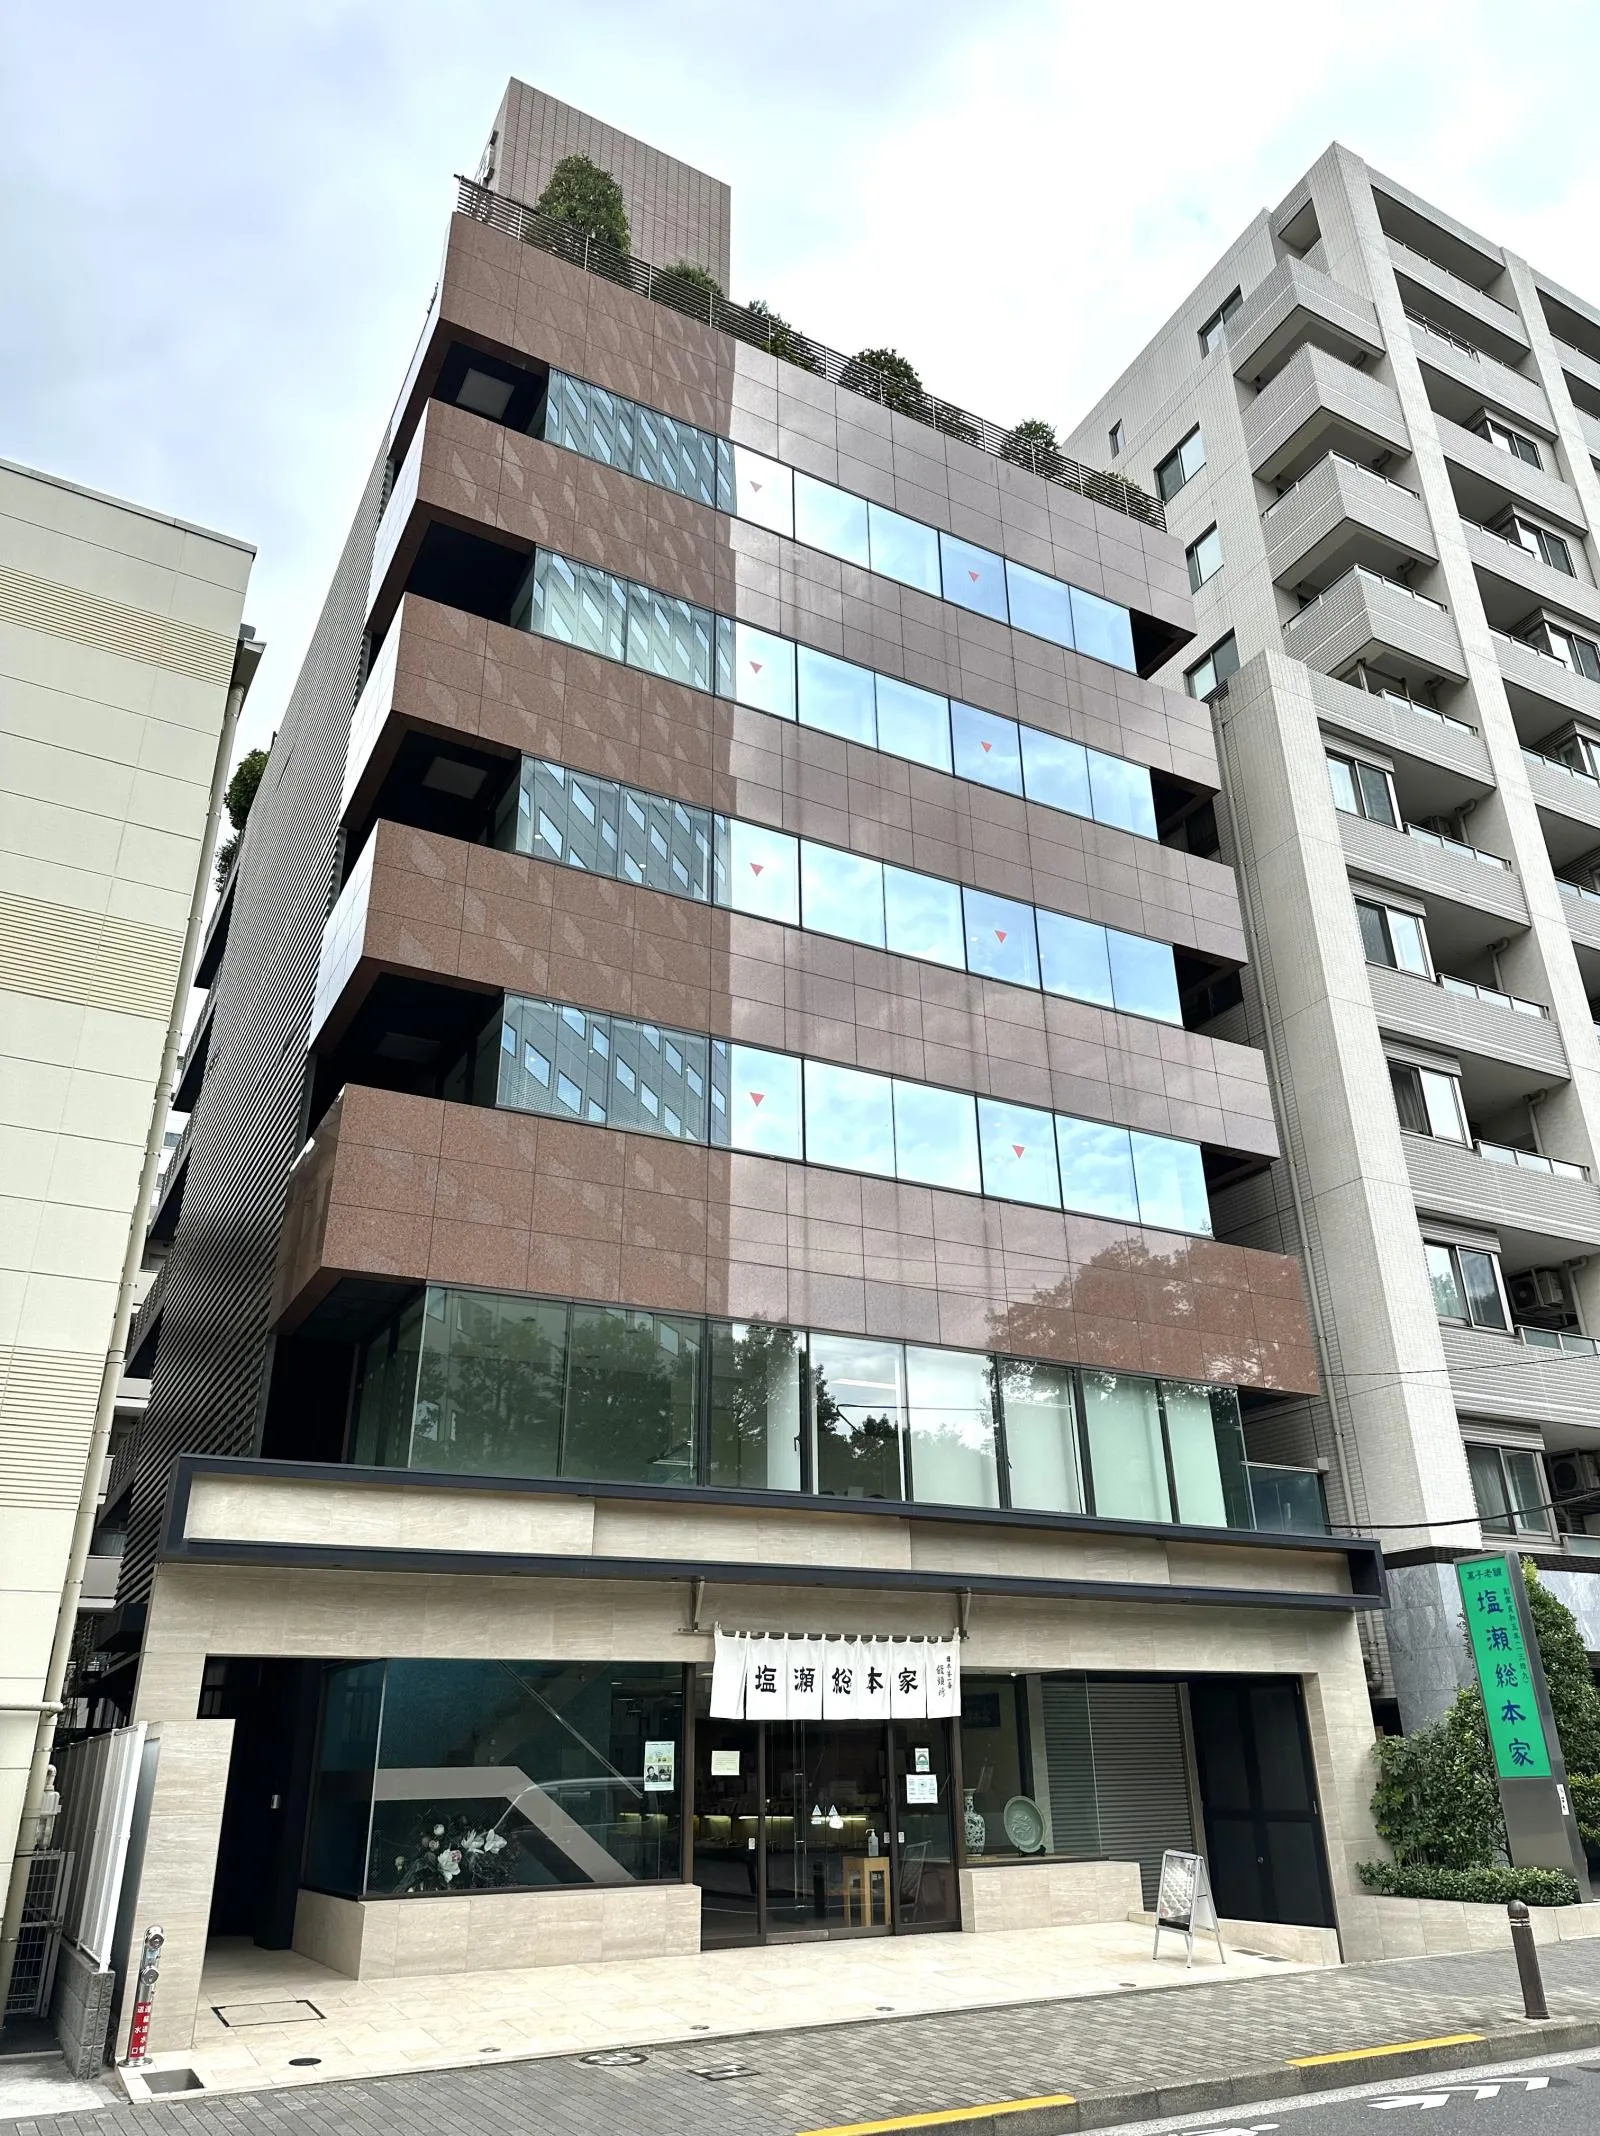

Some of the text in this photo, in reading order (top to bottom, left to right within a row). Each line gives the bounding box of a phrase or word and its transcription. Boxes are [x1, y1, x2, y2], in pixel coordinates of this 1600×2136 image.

[755, 1665, 919, 1695] 塩瀬総本家
[1477, 1589, 1535, 1767] 塩瀬総本家
[131, 2005, 145, 2055] 送水口
